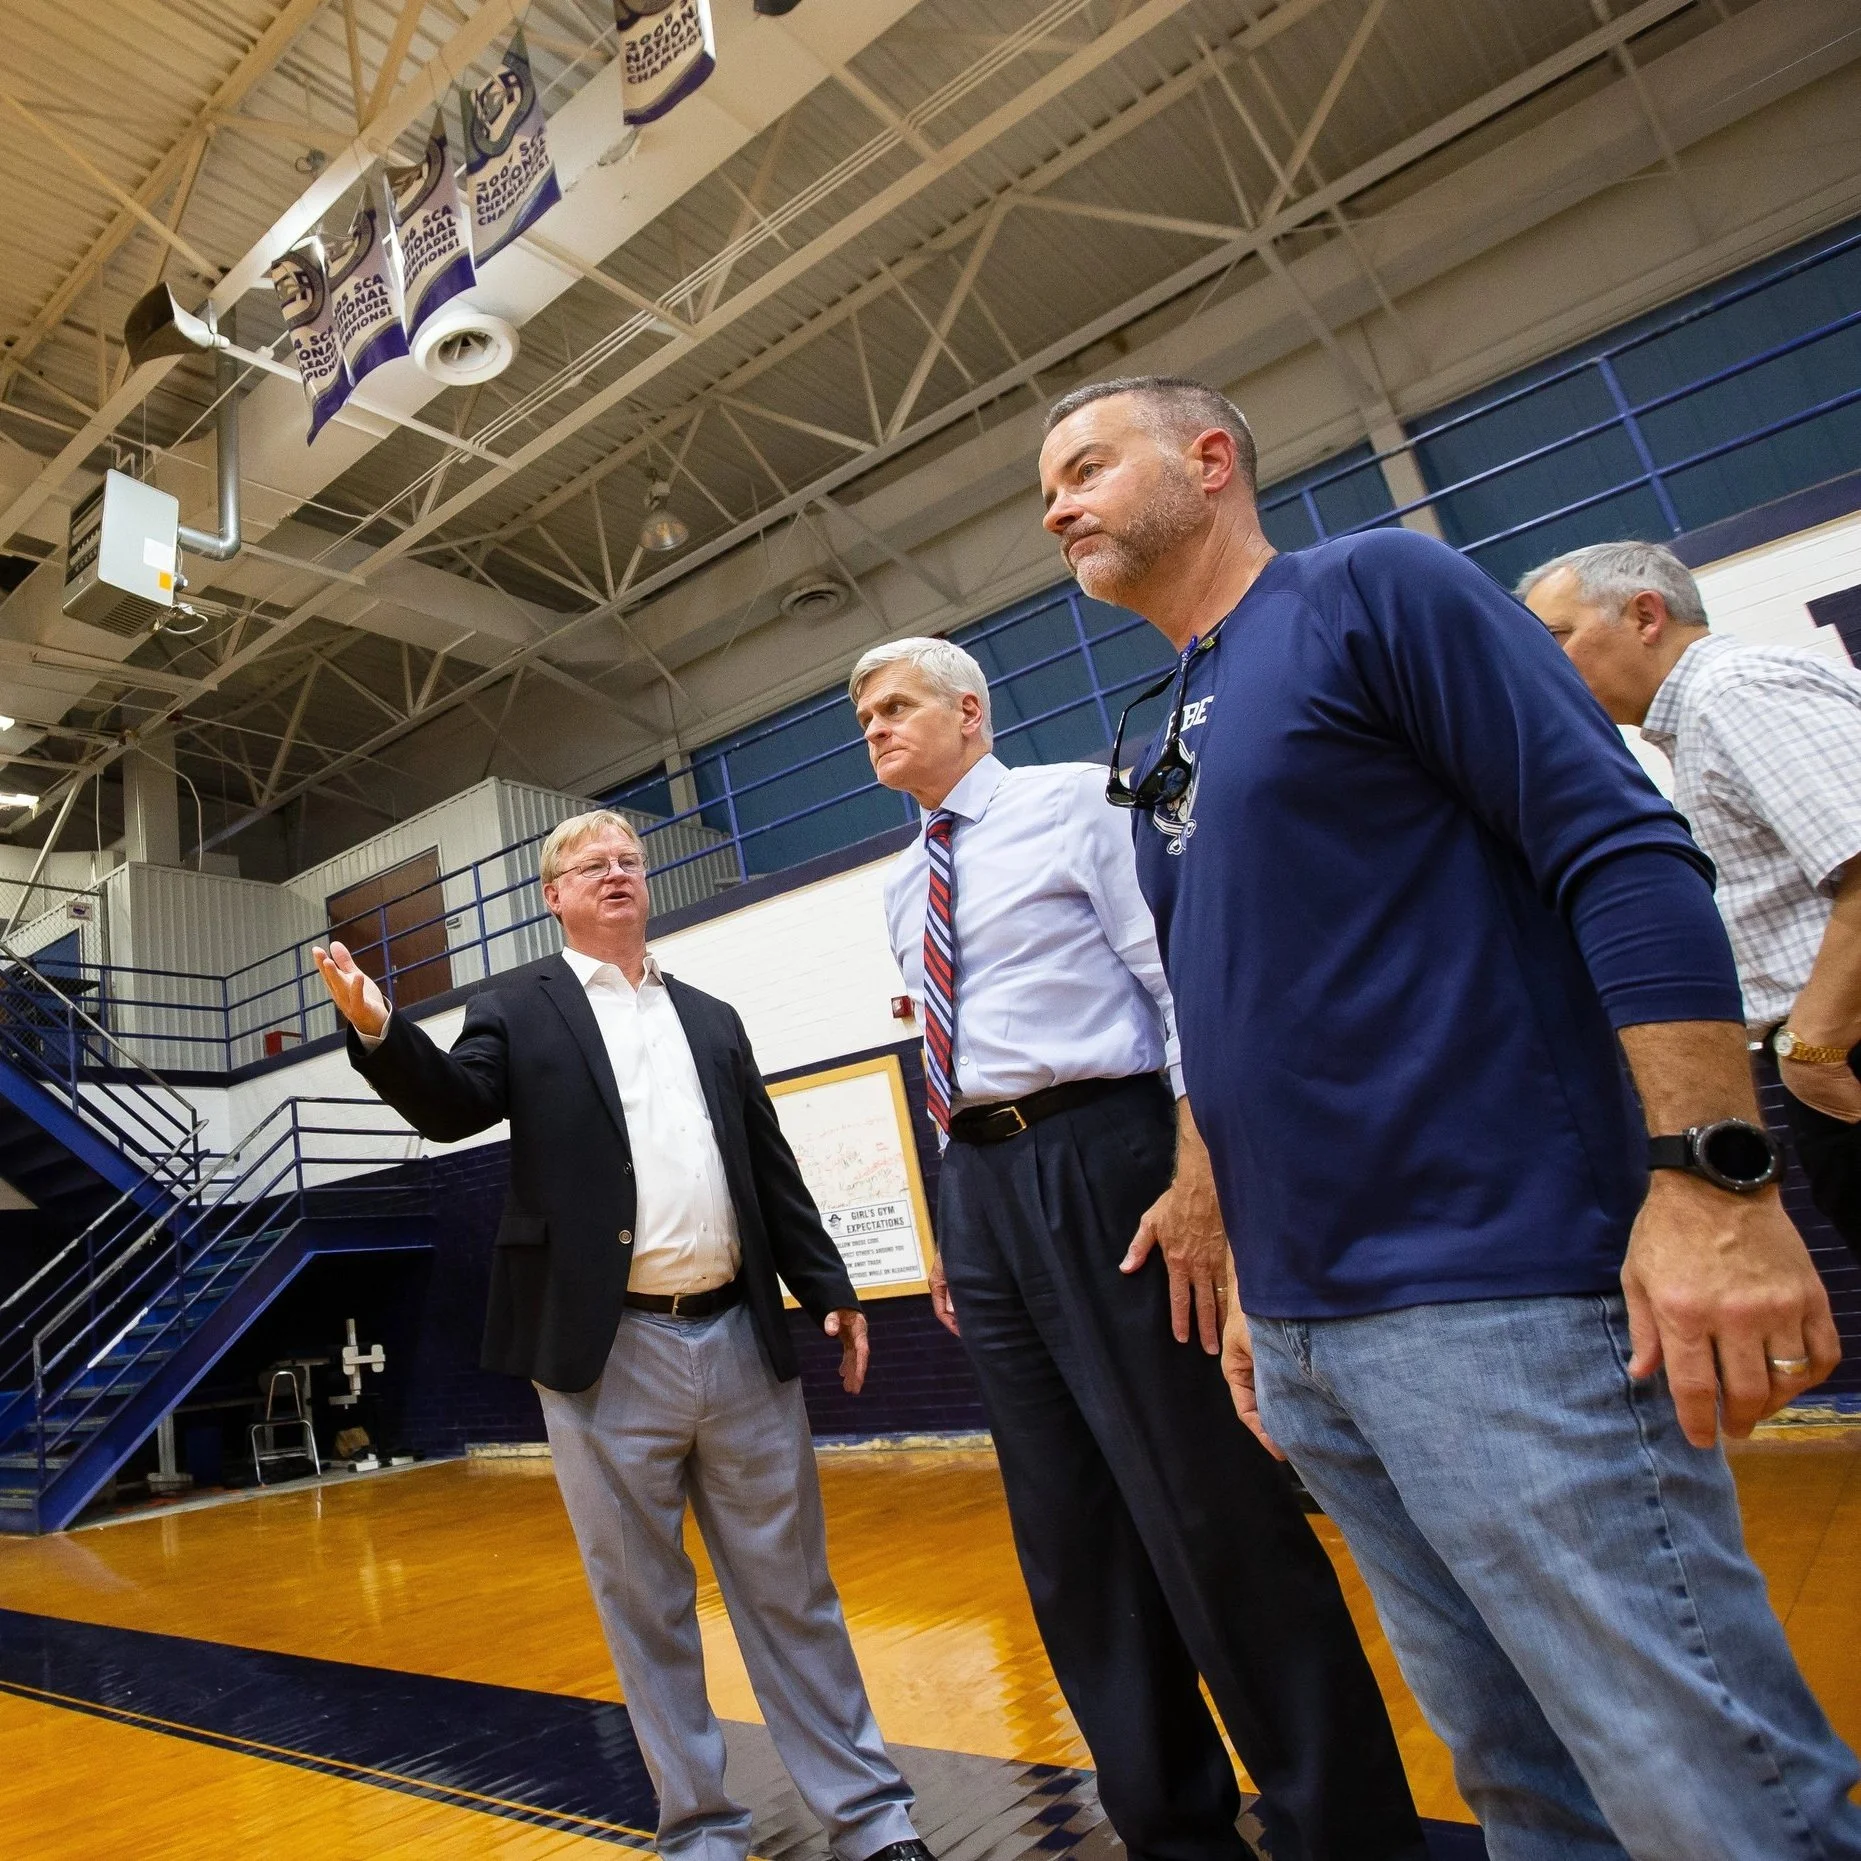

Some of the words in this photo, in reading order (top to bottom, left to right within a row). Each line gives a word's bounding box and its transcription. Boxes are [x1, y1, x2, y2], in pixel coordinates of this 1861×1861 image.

[626, 5, 695, 63] NATION
[627, 28, 702, 84] CHAMPIO
[423, 204, 453, 228] SCA
[354, 273, 384, 295] SCA
[851, 1208, 875, 1220] GIRL'S
[878, 1206, 895, 1215] GYM
[846, 1217, 905, 1233] EXPECTATIONS
